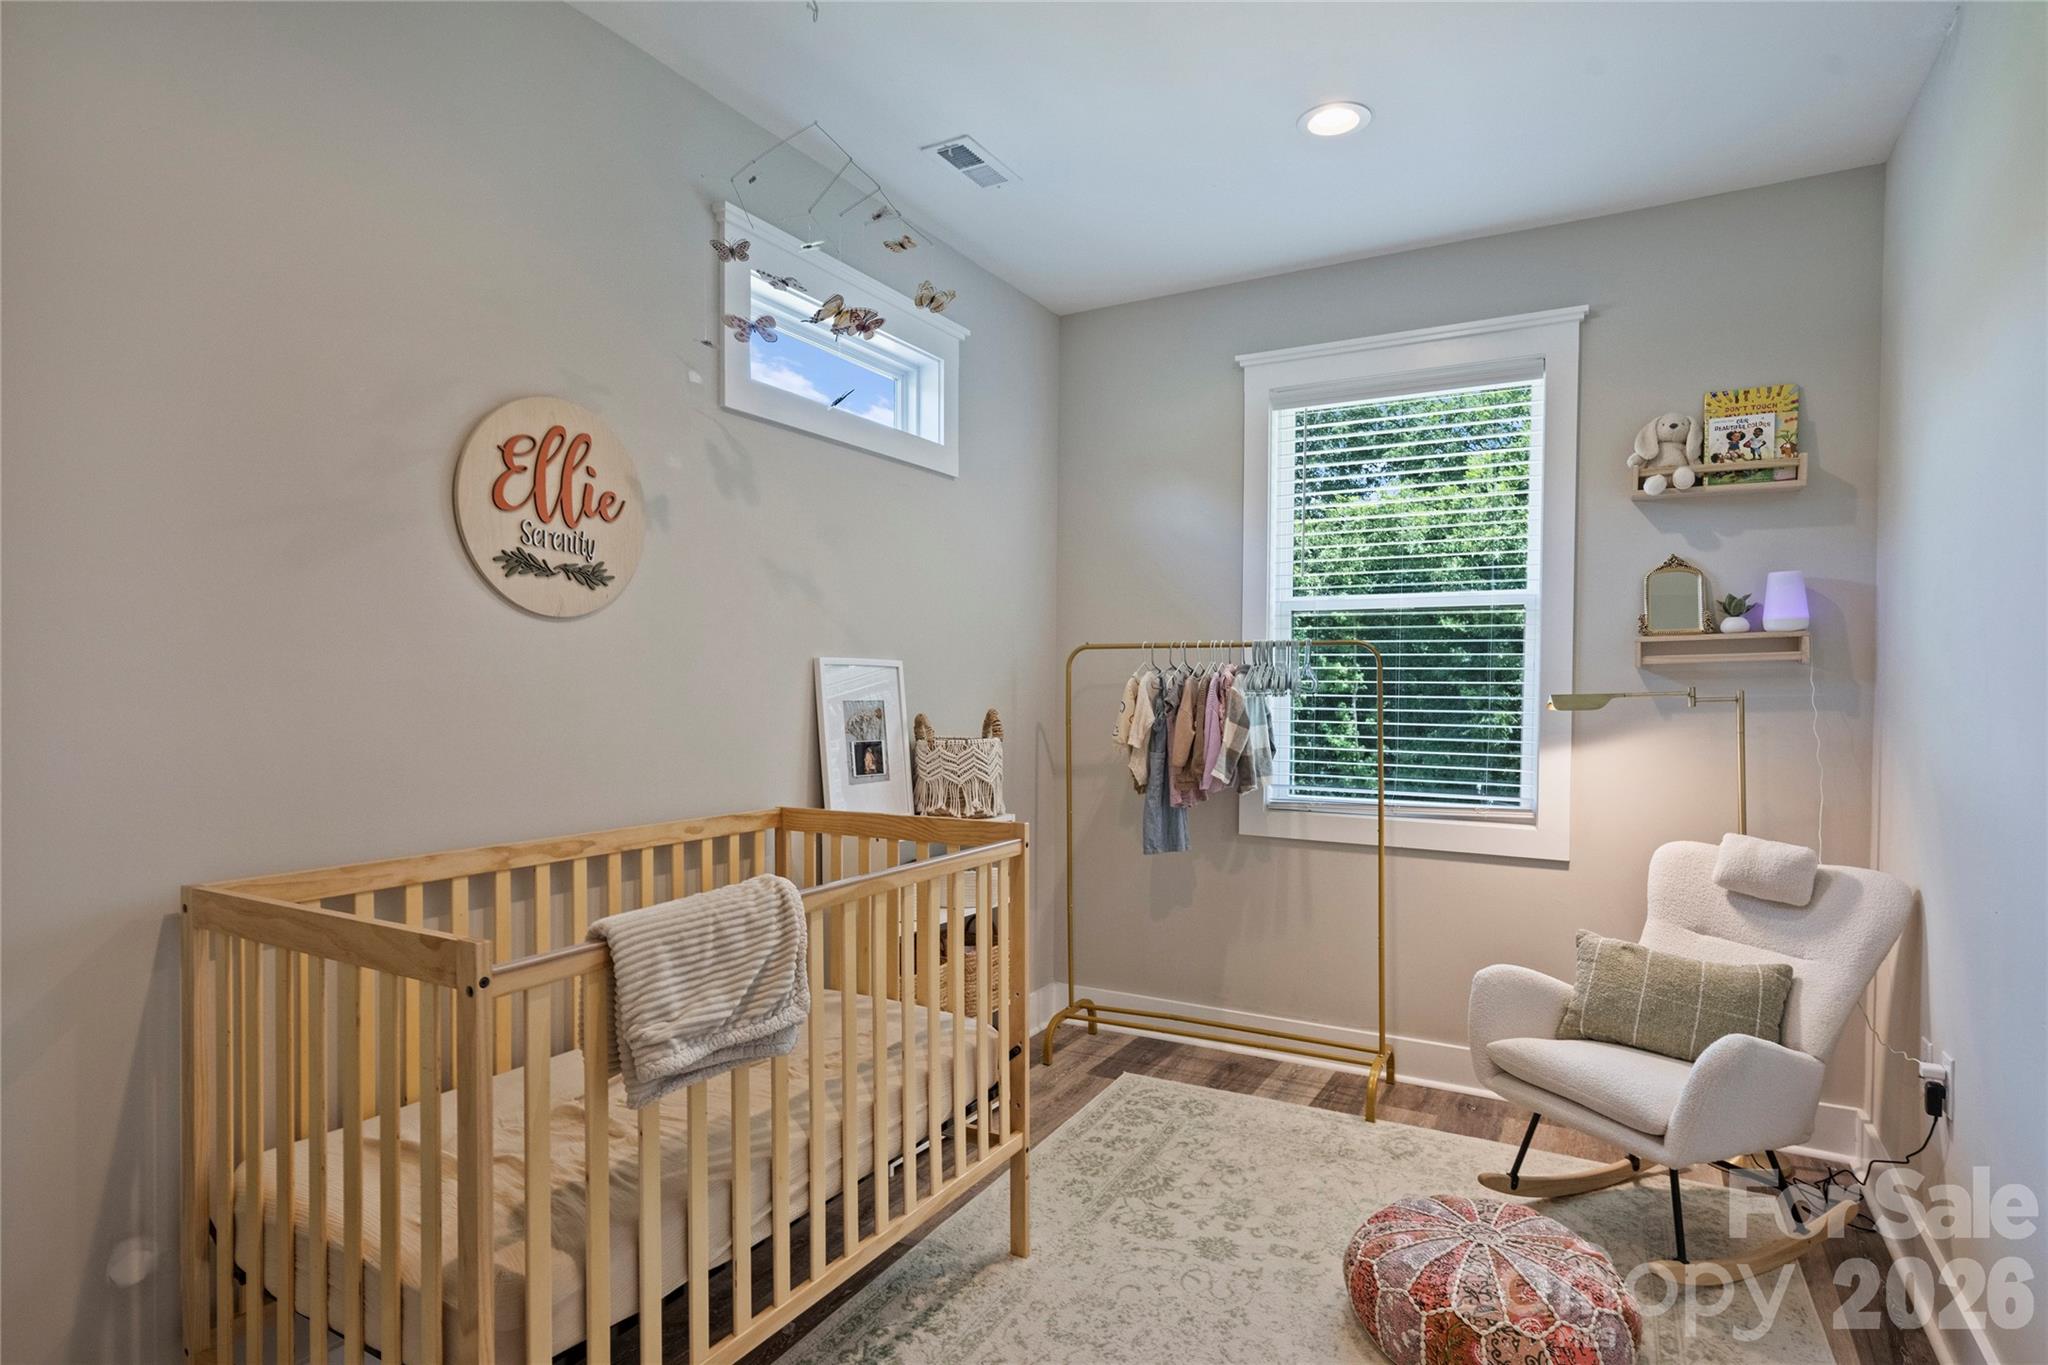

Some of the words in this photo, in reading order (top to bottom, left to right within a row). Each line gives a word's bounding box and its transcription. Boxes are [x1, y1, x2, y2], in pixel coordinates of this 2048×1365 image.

[1724, 404, 1748, 413] DON'T
[1751, 402, 1778, 410] TOUCH
[492, 425, 625, 529] Ellie
[520, 518, 596, 563] Serenity
